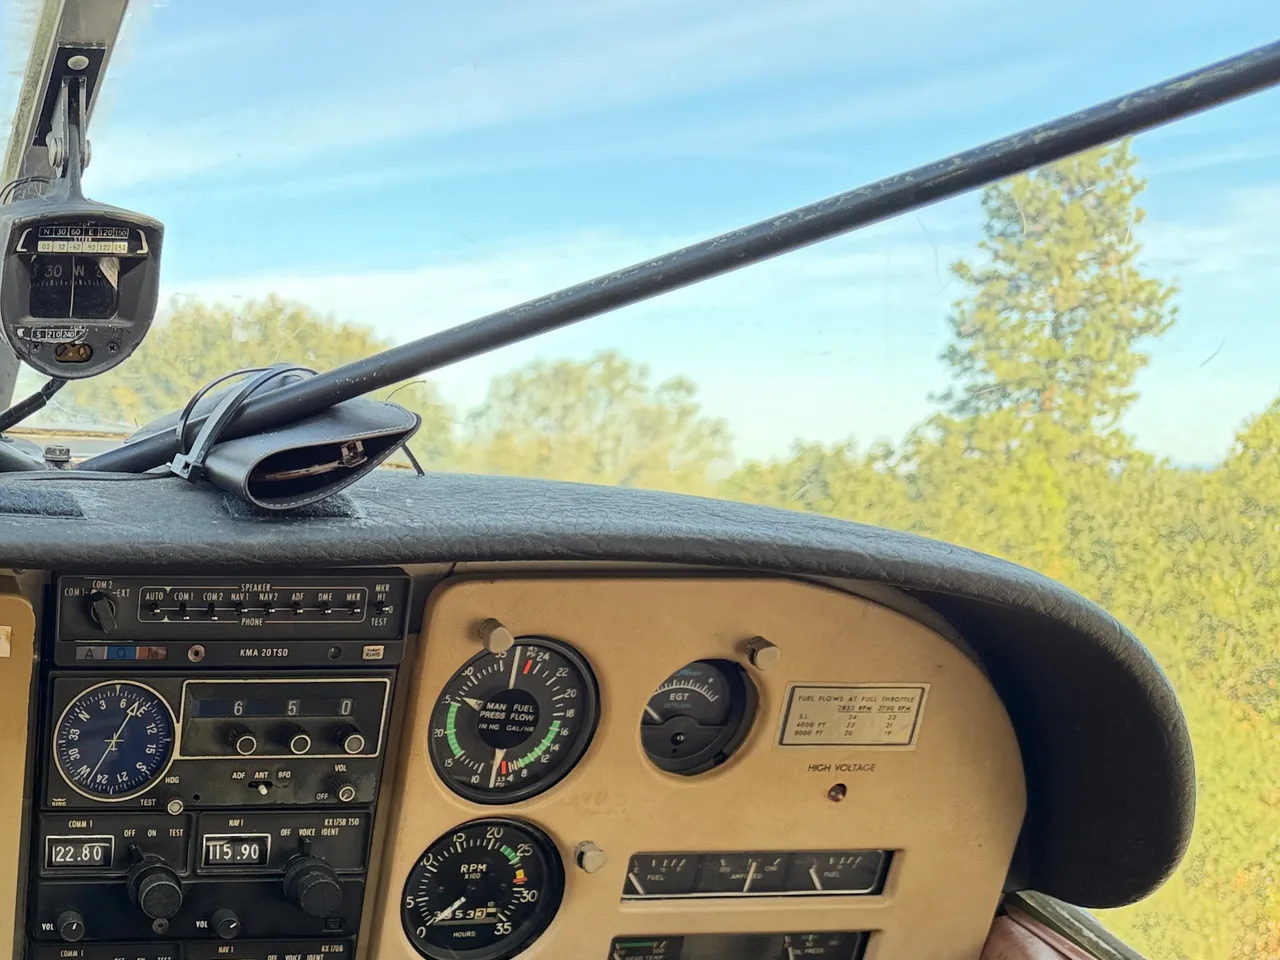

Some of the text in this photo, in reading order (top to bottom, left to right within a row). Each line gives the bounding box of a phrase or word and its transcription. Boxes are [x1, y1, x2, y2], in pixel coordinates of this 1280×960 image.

[45, 265, 62, 277] 30
[241, 583, 271, 592] SPEAKER
[145, 592, 163, 600] AUTO
[318, 593, 332, 601] DME
[346, 593, 360, 601] MKR
[242, 618, 263, 626] PHONE
[371, 618, 387, 626] TEST
[240, 649, 260, 657] KMA
[486, 703, 506, 711] MAN
[513, 704, 534, 712] FUEL
[480, 712, 505, 720] PRESS
[510, 713, 535, 721] FLOW
[69, 729, 80, 740] 33
[808, 764, 876, 772] HIGH VOLTAGE
[69, 820, 87, 828] COMM
[124, 829, 136, 837] OFF
[169, 829, 184, 837] TEST
[52, 845, 102, 862] 122.80
[209, 843, 259, 860] 115.90
[461, 863, 487, 873] RPM
[42, 923, 54, 931] VOL
